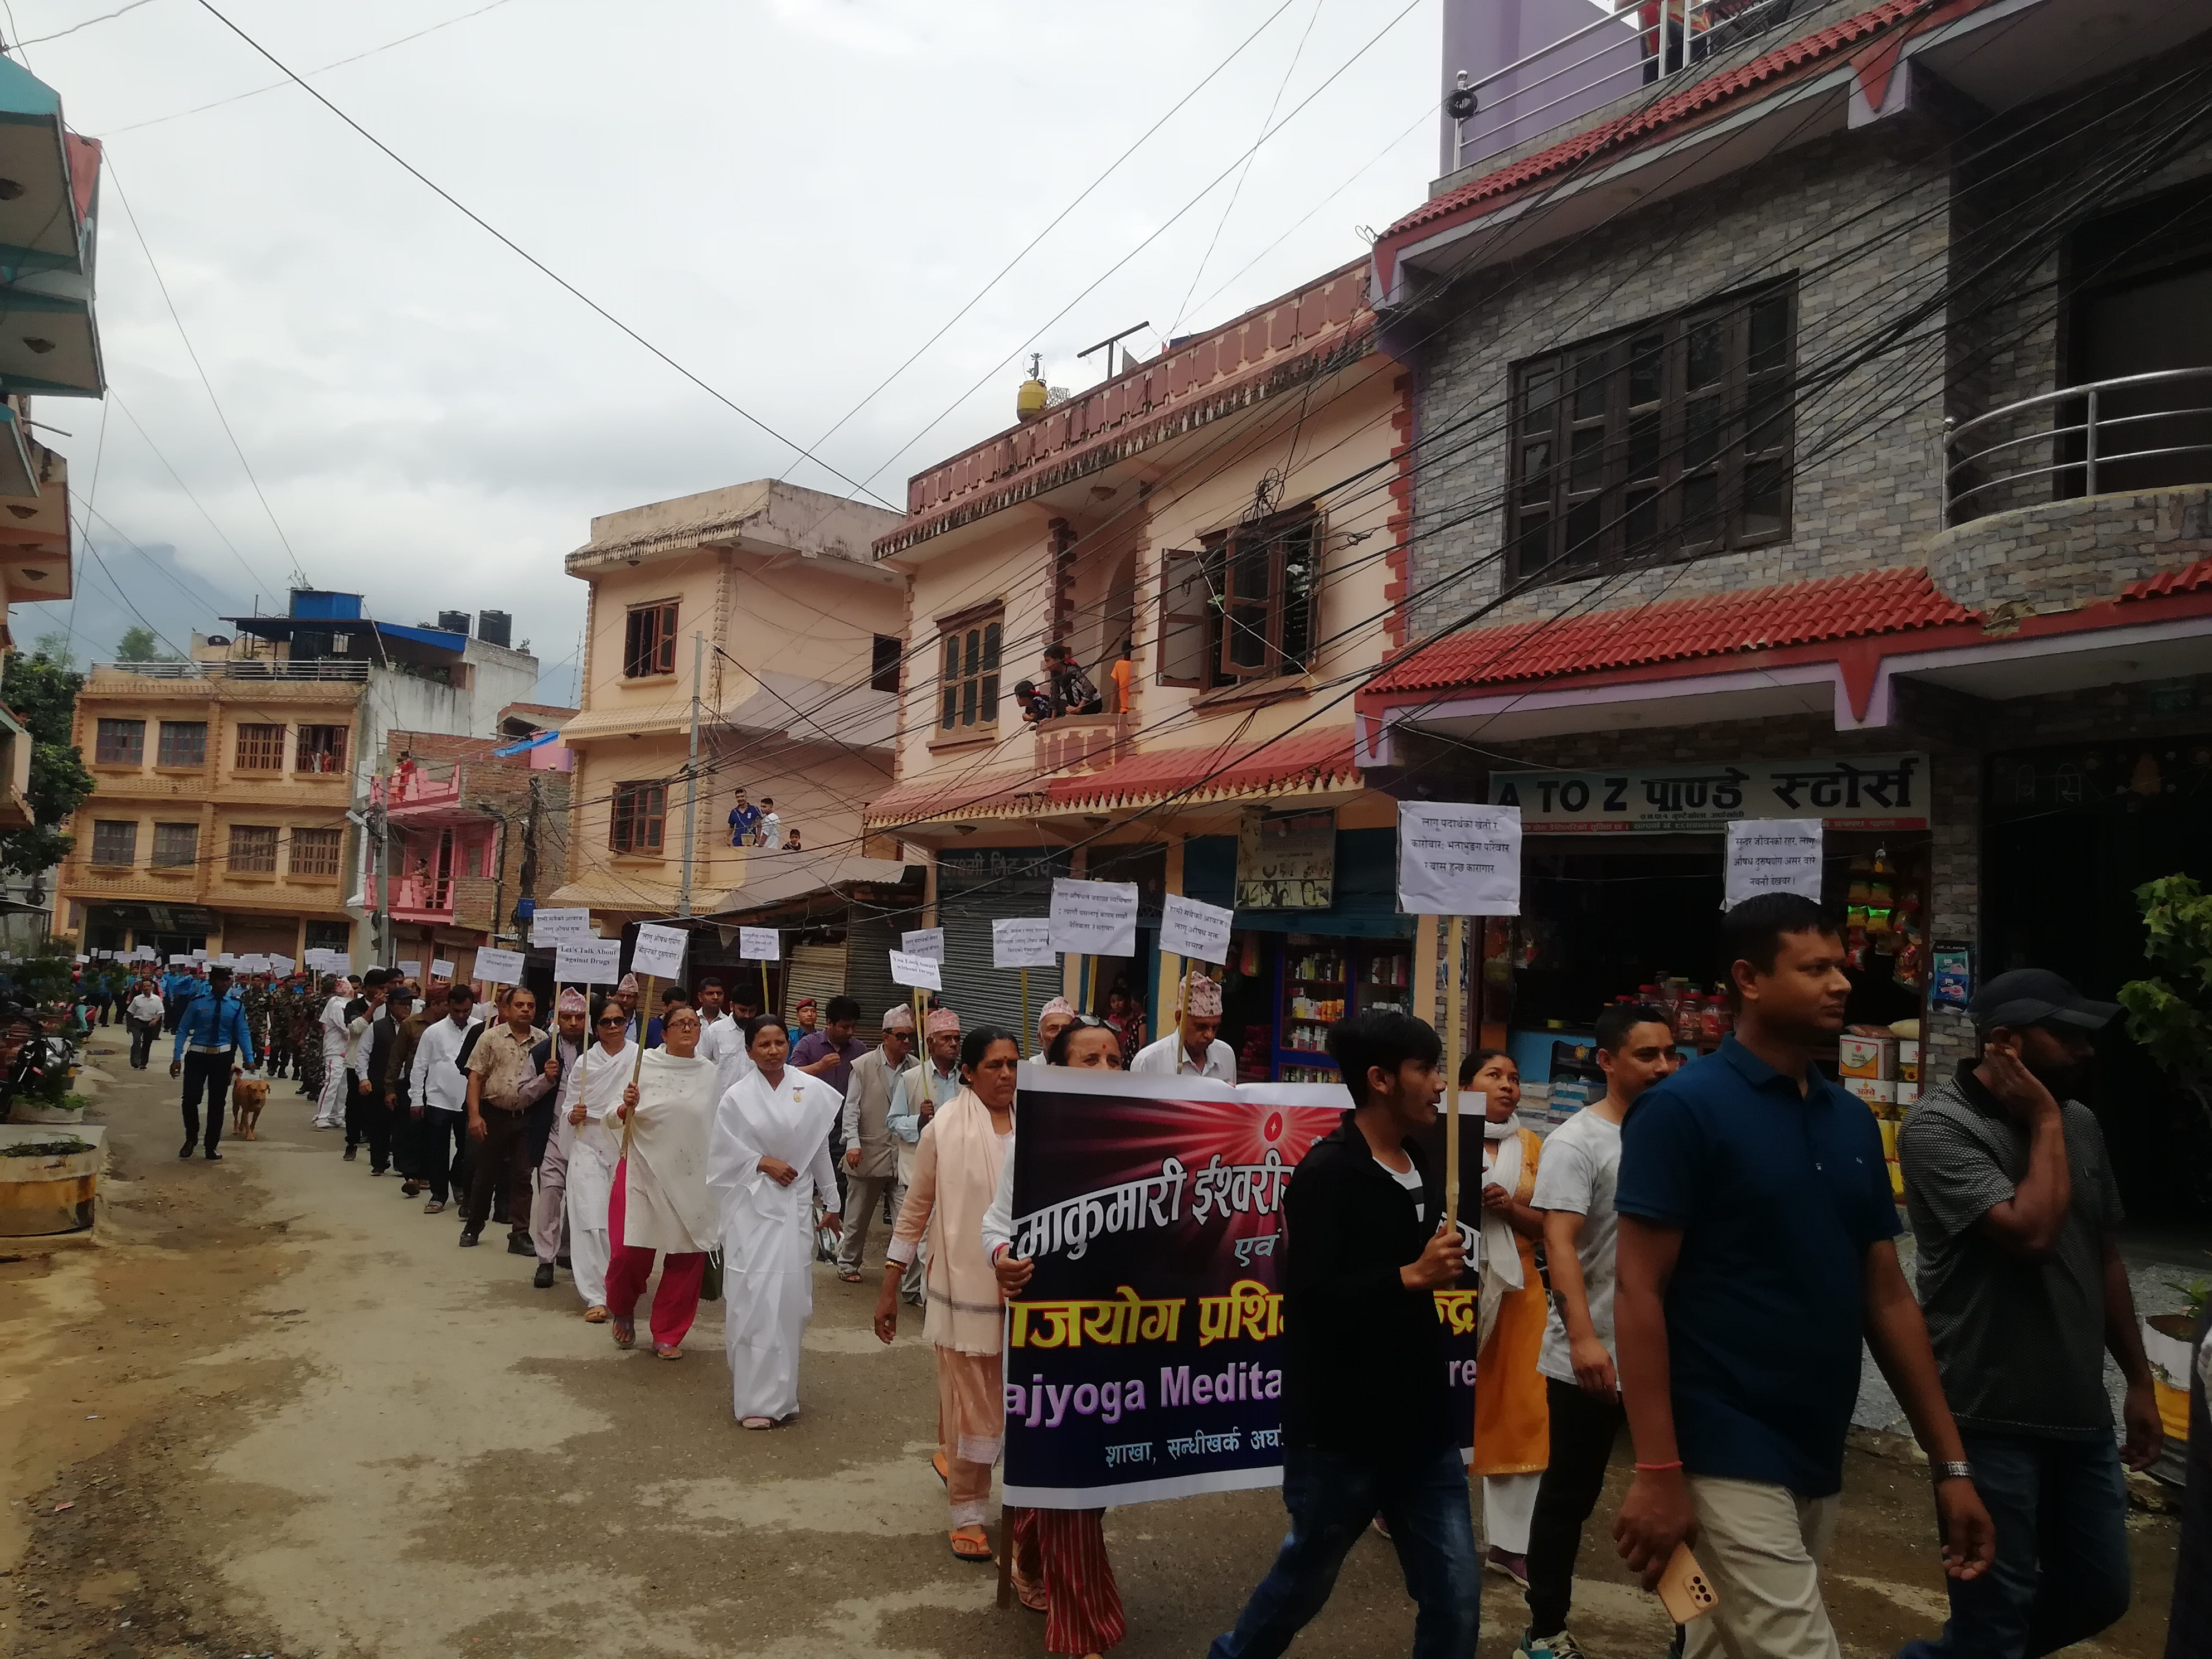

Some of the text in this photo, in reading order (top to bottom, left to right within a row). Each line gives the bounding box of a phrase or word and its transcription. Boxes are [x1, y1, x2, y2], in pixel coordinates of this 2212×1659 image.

[1498, 782, 1520, 806] A
[1603, 778, 1628, 812] Z
[1640, 767, 1750, 811] पाण्डे
[1771, 757, 1919, 811] स्टोर्स
[1422, 818, 1441, 832] लागू
[1440, 816, 1474, 830] पदार्थको
[1475, 818, 1492, 831] खेती
[1484, 840, 1510, 853] परिवार
[1735, 837, 1752, 850] सुन्दर
[1754, 834, 1782, 846] जीवनको
[1734, 854, 1753, 866] औषध
[1466, 864, 1496, 874] कारागार
[1170, 905, 1183, 915] हामी
[1204, 915, 1224, 925] आवाज
[1189, 926, 1206, 937] औषध
[1185, 941, 1204, 950] समाज
[1234, 1228, 1282, 1267] एवं
[1009, 1286, 1186, 1348] ाजयोग
[1199, 1280, 1284, 1348] प्रशि
[1005, 1362, 1282, 1428] ajyoga Medita
[1167, 1426, 1241, 1460] सन्धीखर्क
